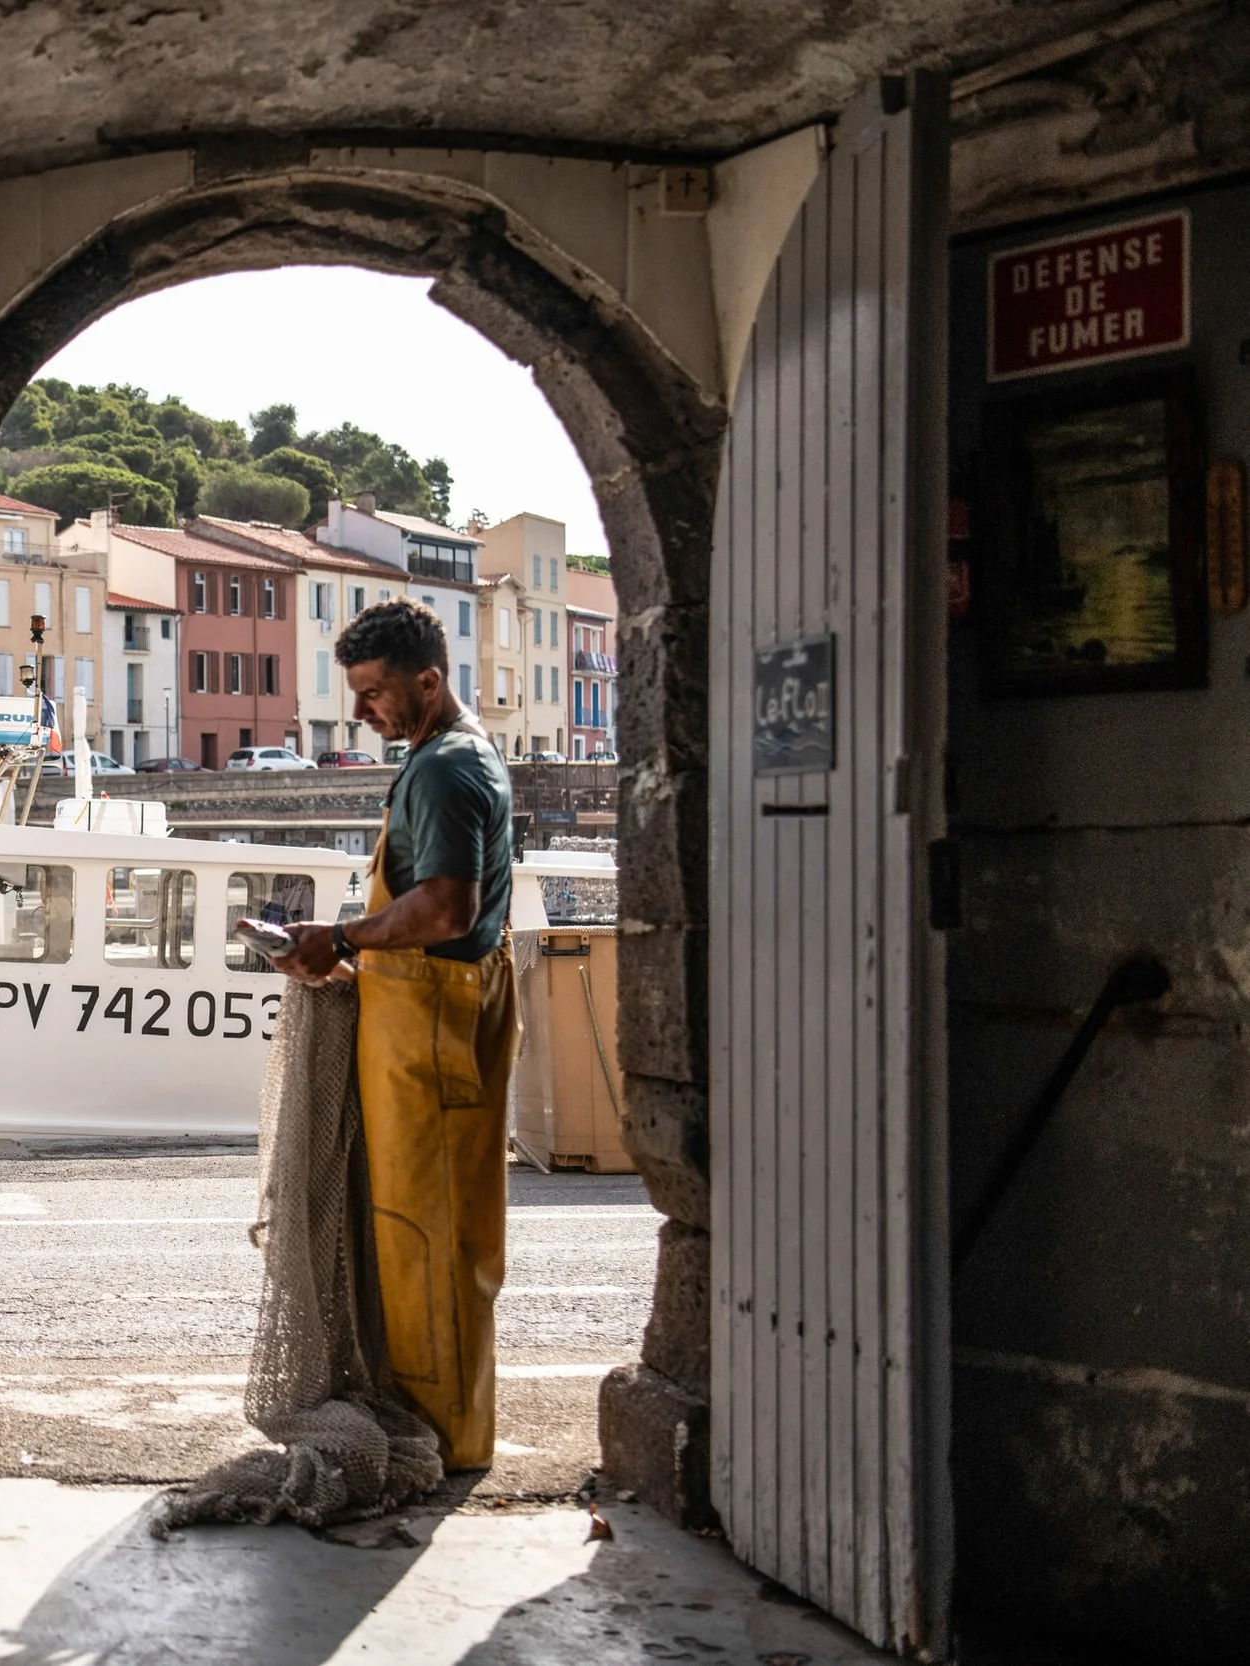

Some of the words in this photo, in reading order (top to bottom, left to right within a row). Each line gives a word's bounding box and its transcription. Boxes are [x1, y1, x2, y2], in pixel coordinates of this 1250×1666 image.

[1065, 281, 1106, 318] DE
[1028, 307, 1145, 358] FUMER
[71, 985, 170, 1036] 742
